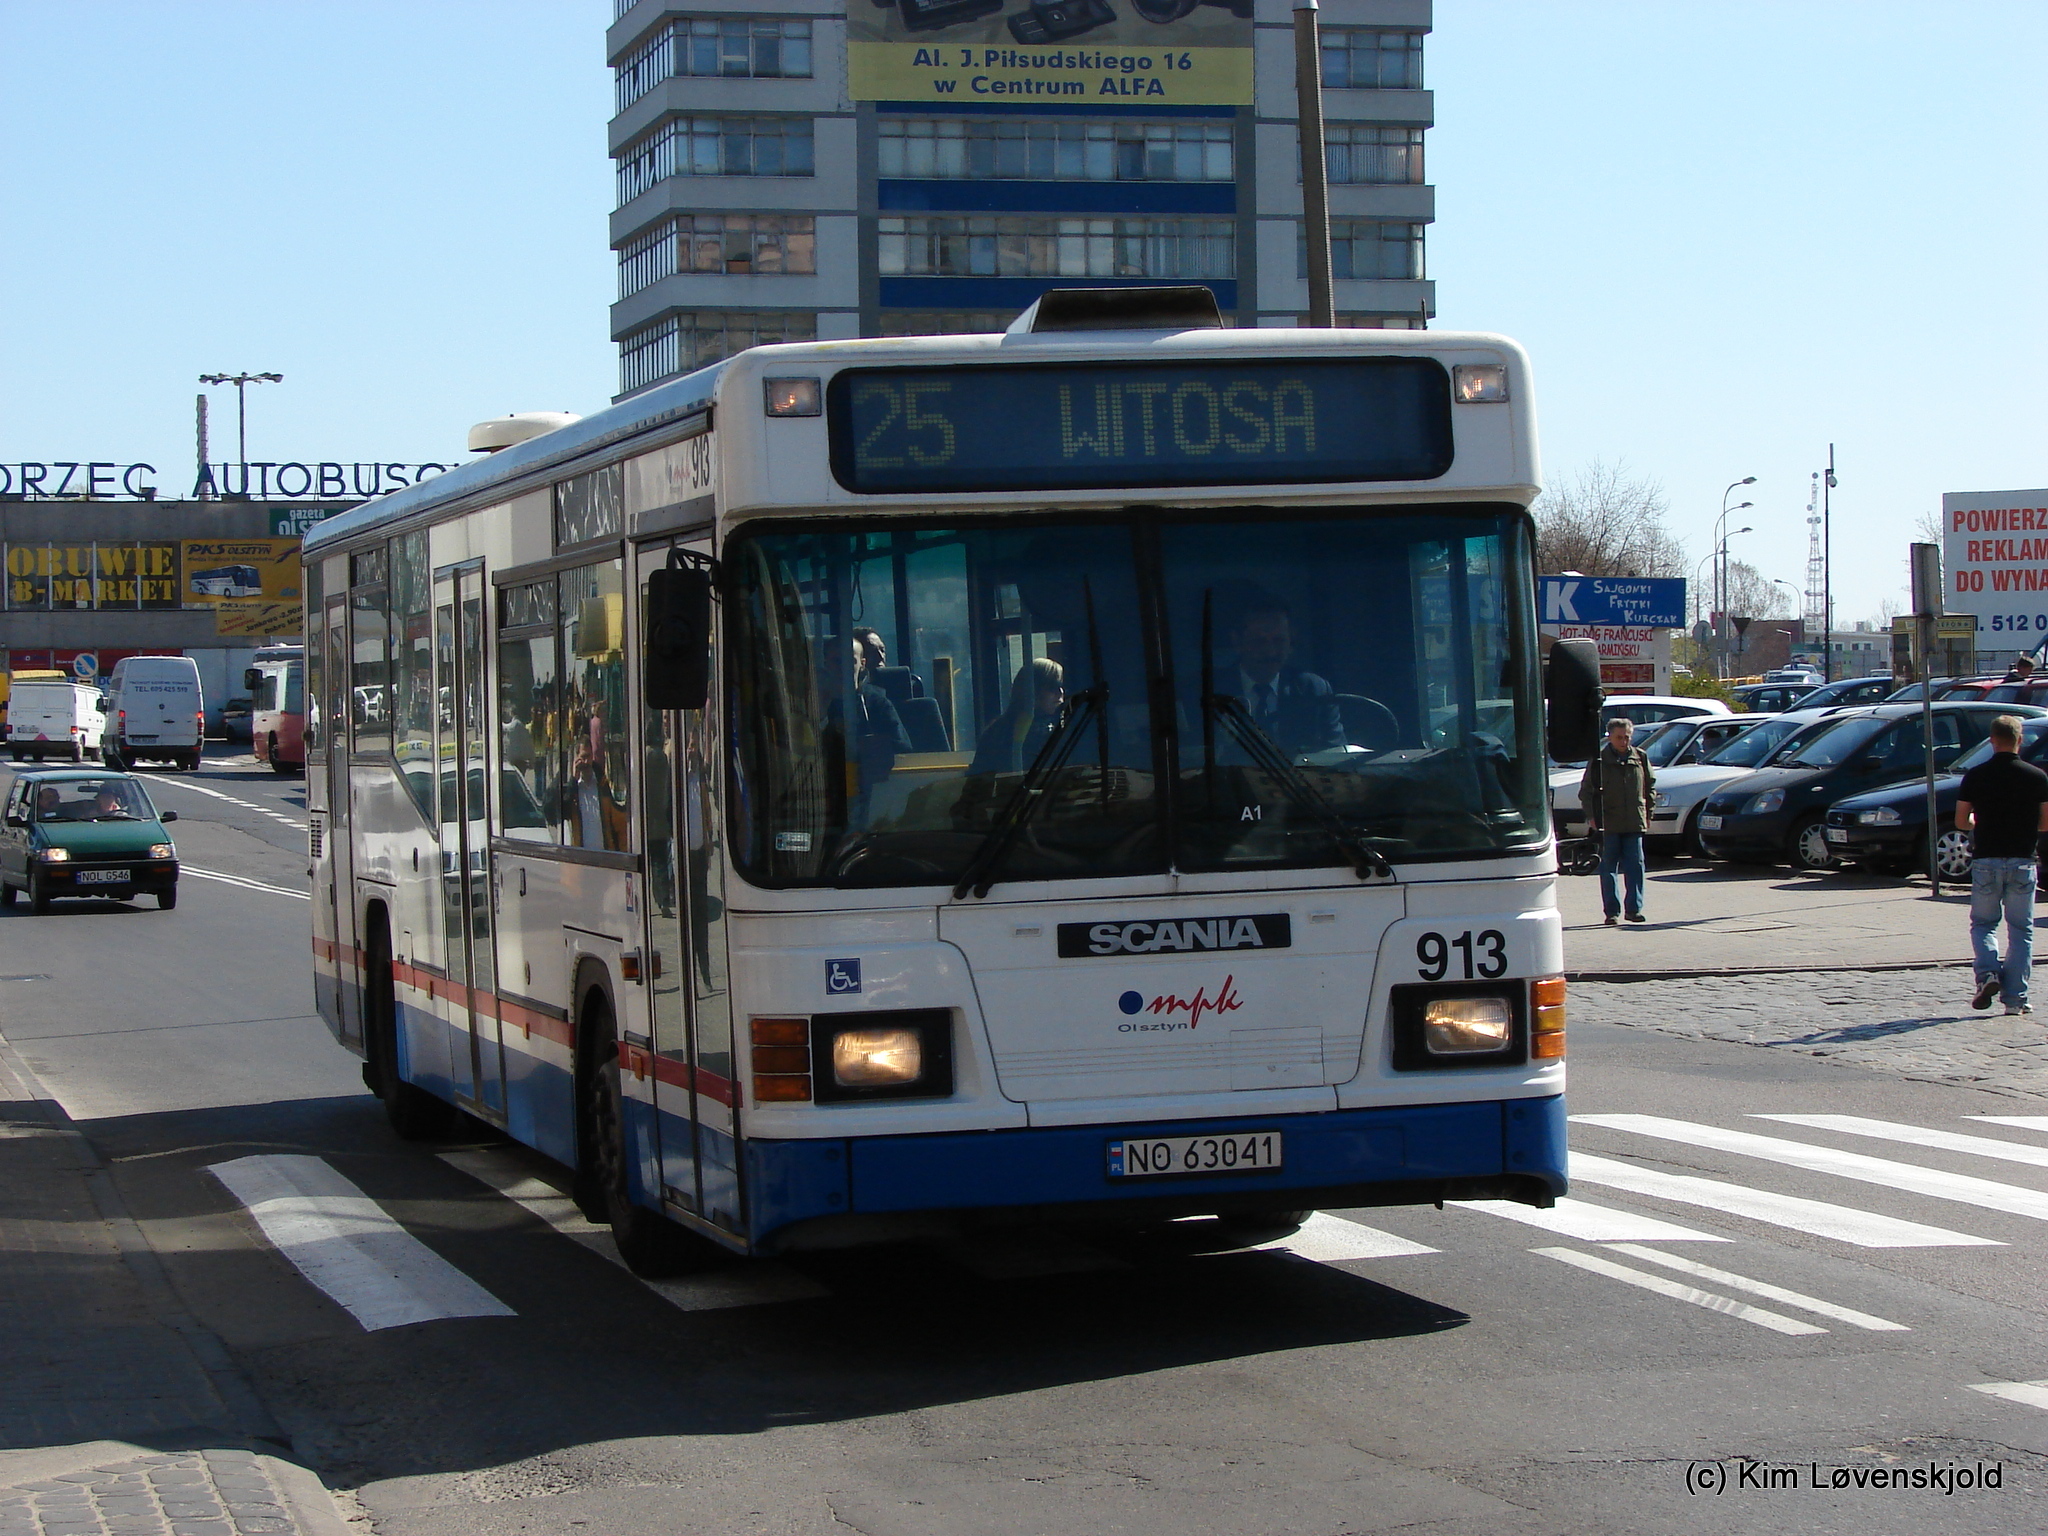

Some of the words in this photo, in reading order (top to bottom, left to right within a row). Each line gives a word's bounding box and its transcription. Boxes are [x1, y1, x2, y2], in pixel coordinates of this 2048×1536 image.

[913, 49, 949, 67] Al.
[1164, 53, 1192, 71] 16
[934, 79, 957, 94] w
[971, 76, 1085, 96] Centrum
[1100, 78, 1165, 96] ALFA
[853, 381, 957, 470] 25
[1061, 379, 1318, 459] WITOSA
[692, 434, 710, 489] 913
[289, 509, 326, 521] gazeta
[1953, 508, 2048, 533] POWIERZ
[188, 544, 226, 556] PKS
[227, 546, 273, 555] OLSZTYN
[1967, 538, 2048, 562] REKLAM
[7, 547, 174, 577] OBUWIE
[1593, 580, 1652, 594] SAJGONKI
[1956, 570, 1984, 593] DO
[1991, 569, 2048, 592] WYNA
[1609, 595, 1651, 609] FRYTKI
[1624, 610, 1678, 624] KURCZAK
[1991, 614, 2029, 632] 512
[1604, 628, 1654, 642] FRANCUSKI
[1597, 643, 1640, 657] ARMIŃSKU
[1241, 806, 1262, 822] A1
[82, 870, 103, 882] NOL
[106, 870, 129, 881] G546
[1088, 917, 1264, 954] SCANIA
[1416, 929, 1508, 982] 913
[1145, 974, 1244, 1030] mpk
[1117, 1022, 1188, 1033] Olsztyn
[1111, 1163, 1123, 1172] PL
[1128, 1142, 1171, 1174] NO
[1183, 1136, 1273, 1170] 63041
